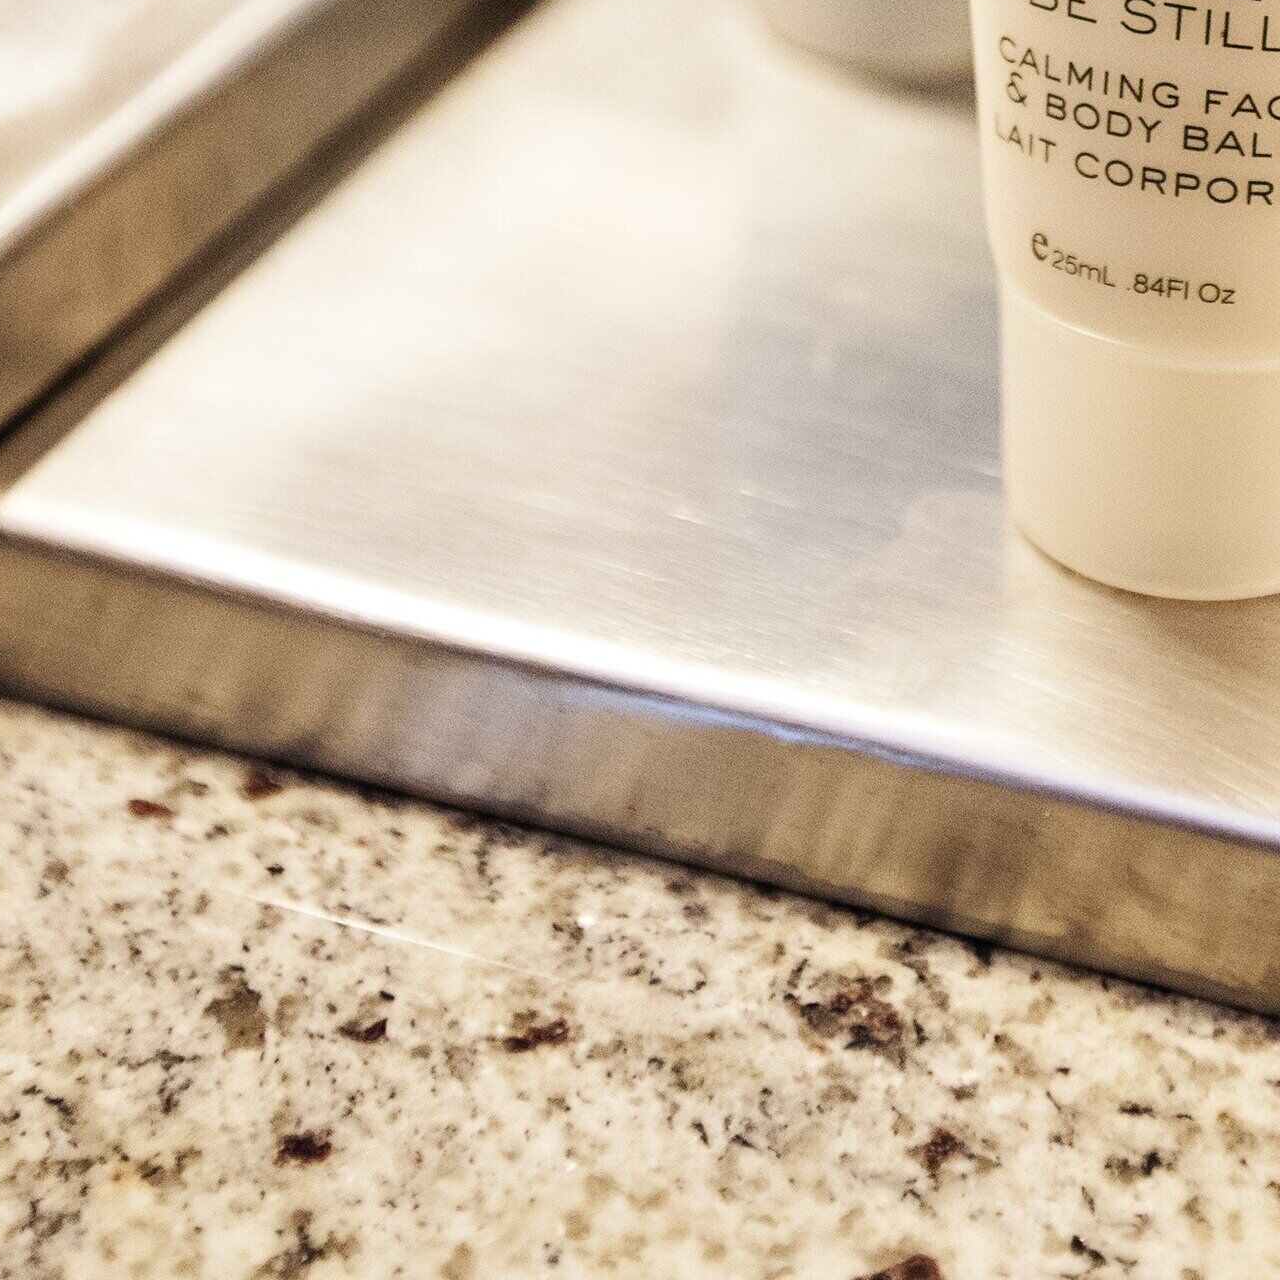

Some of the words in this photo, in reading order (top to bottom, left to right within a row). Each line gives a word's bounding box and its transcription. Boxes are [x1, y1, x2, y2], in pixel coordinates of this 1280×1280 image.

[998, 35, 1180, 109] CALMING
[994, 111, 1057, 164] LAIT
[1006, 71, 1028, 108] &
[1046, 92, 1161, 144] BODY
[1198, 282, 1237, 305] Oz
